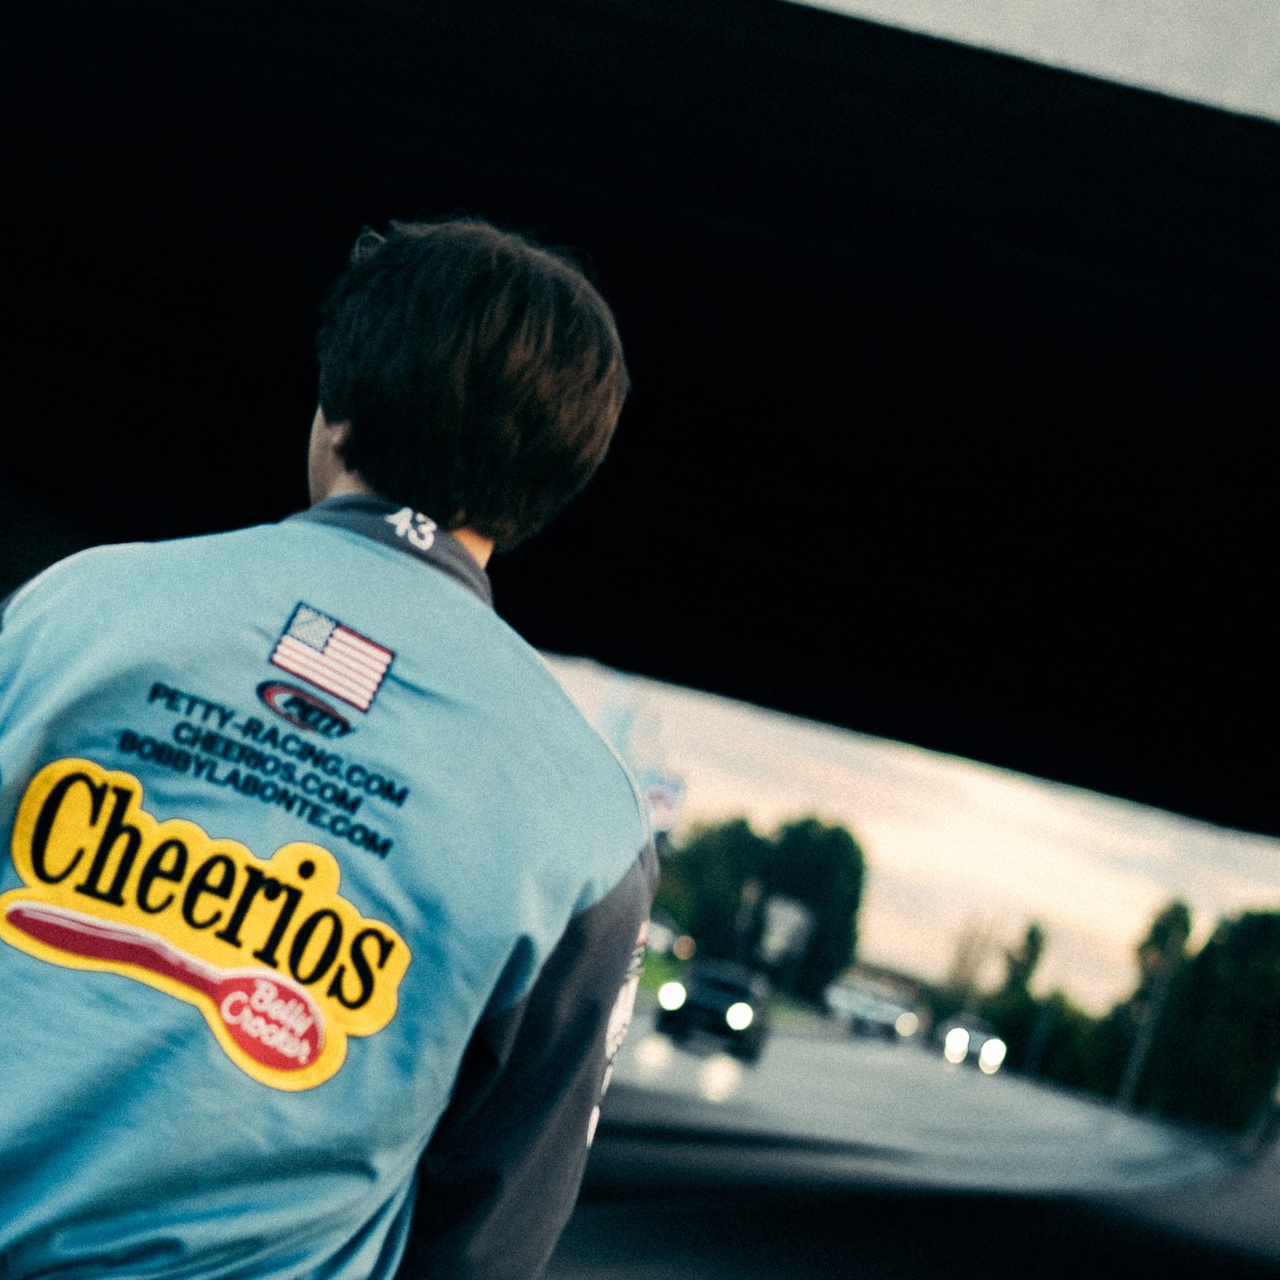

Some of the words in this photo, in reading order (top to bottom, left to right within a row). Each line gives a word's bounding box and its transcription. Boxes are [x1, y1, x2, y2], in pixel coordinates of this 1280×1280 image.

[384, 506, 438, 551] 43
[117, 728, 395, 860] BOBBYLABONTE.COM
[146, 681, 411, 808] PETTY-RACING.COM
[172, 721, 364, 815] CHEERIOS.COM
[30, 772, 396, 1011] Cheerios
